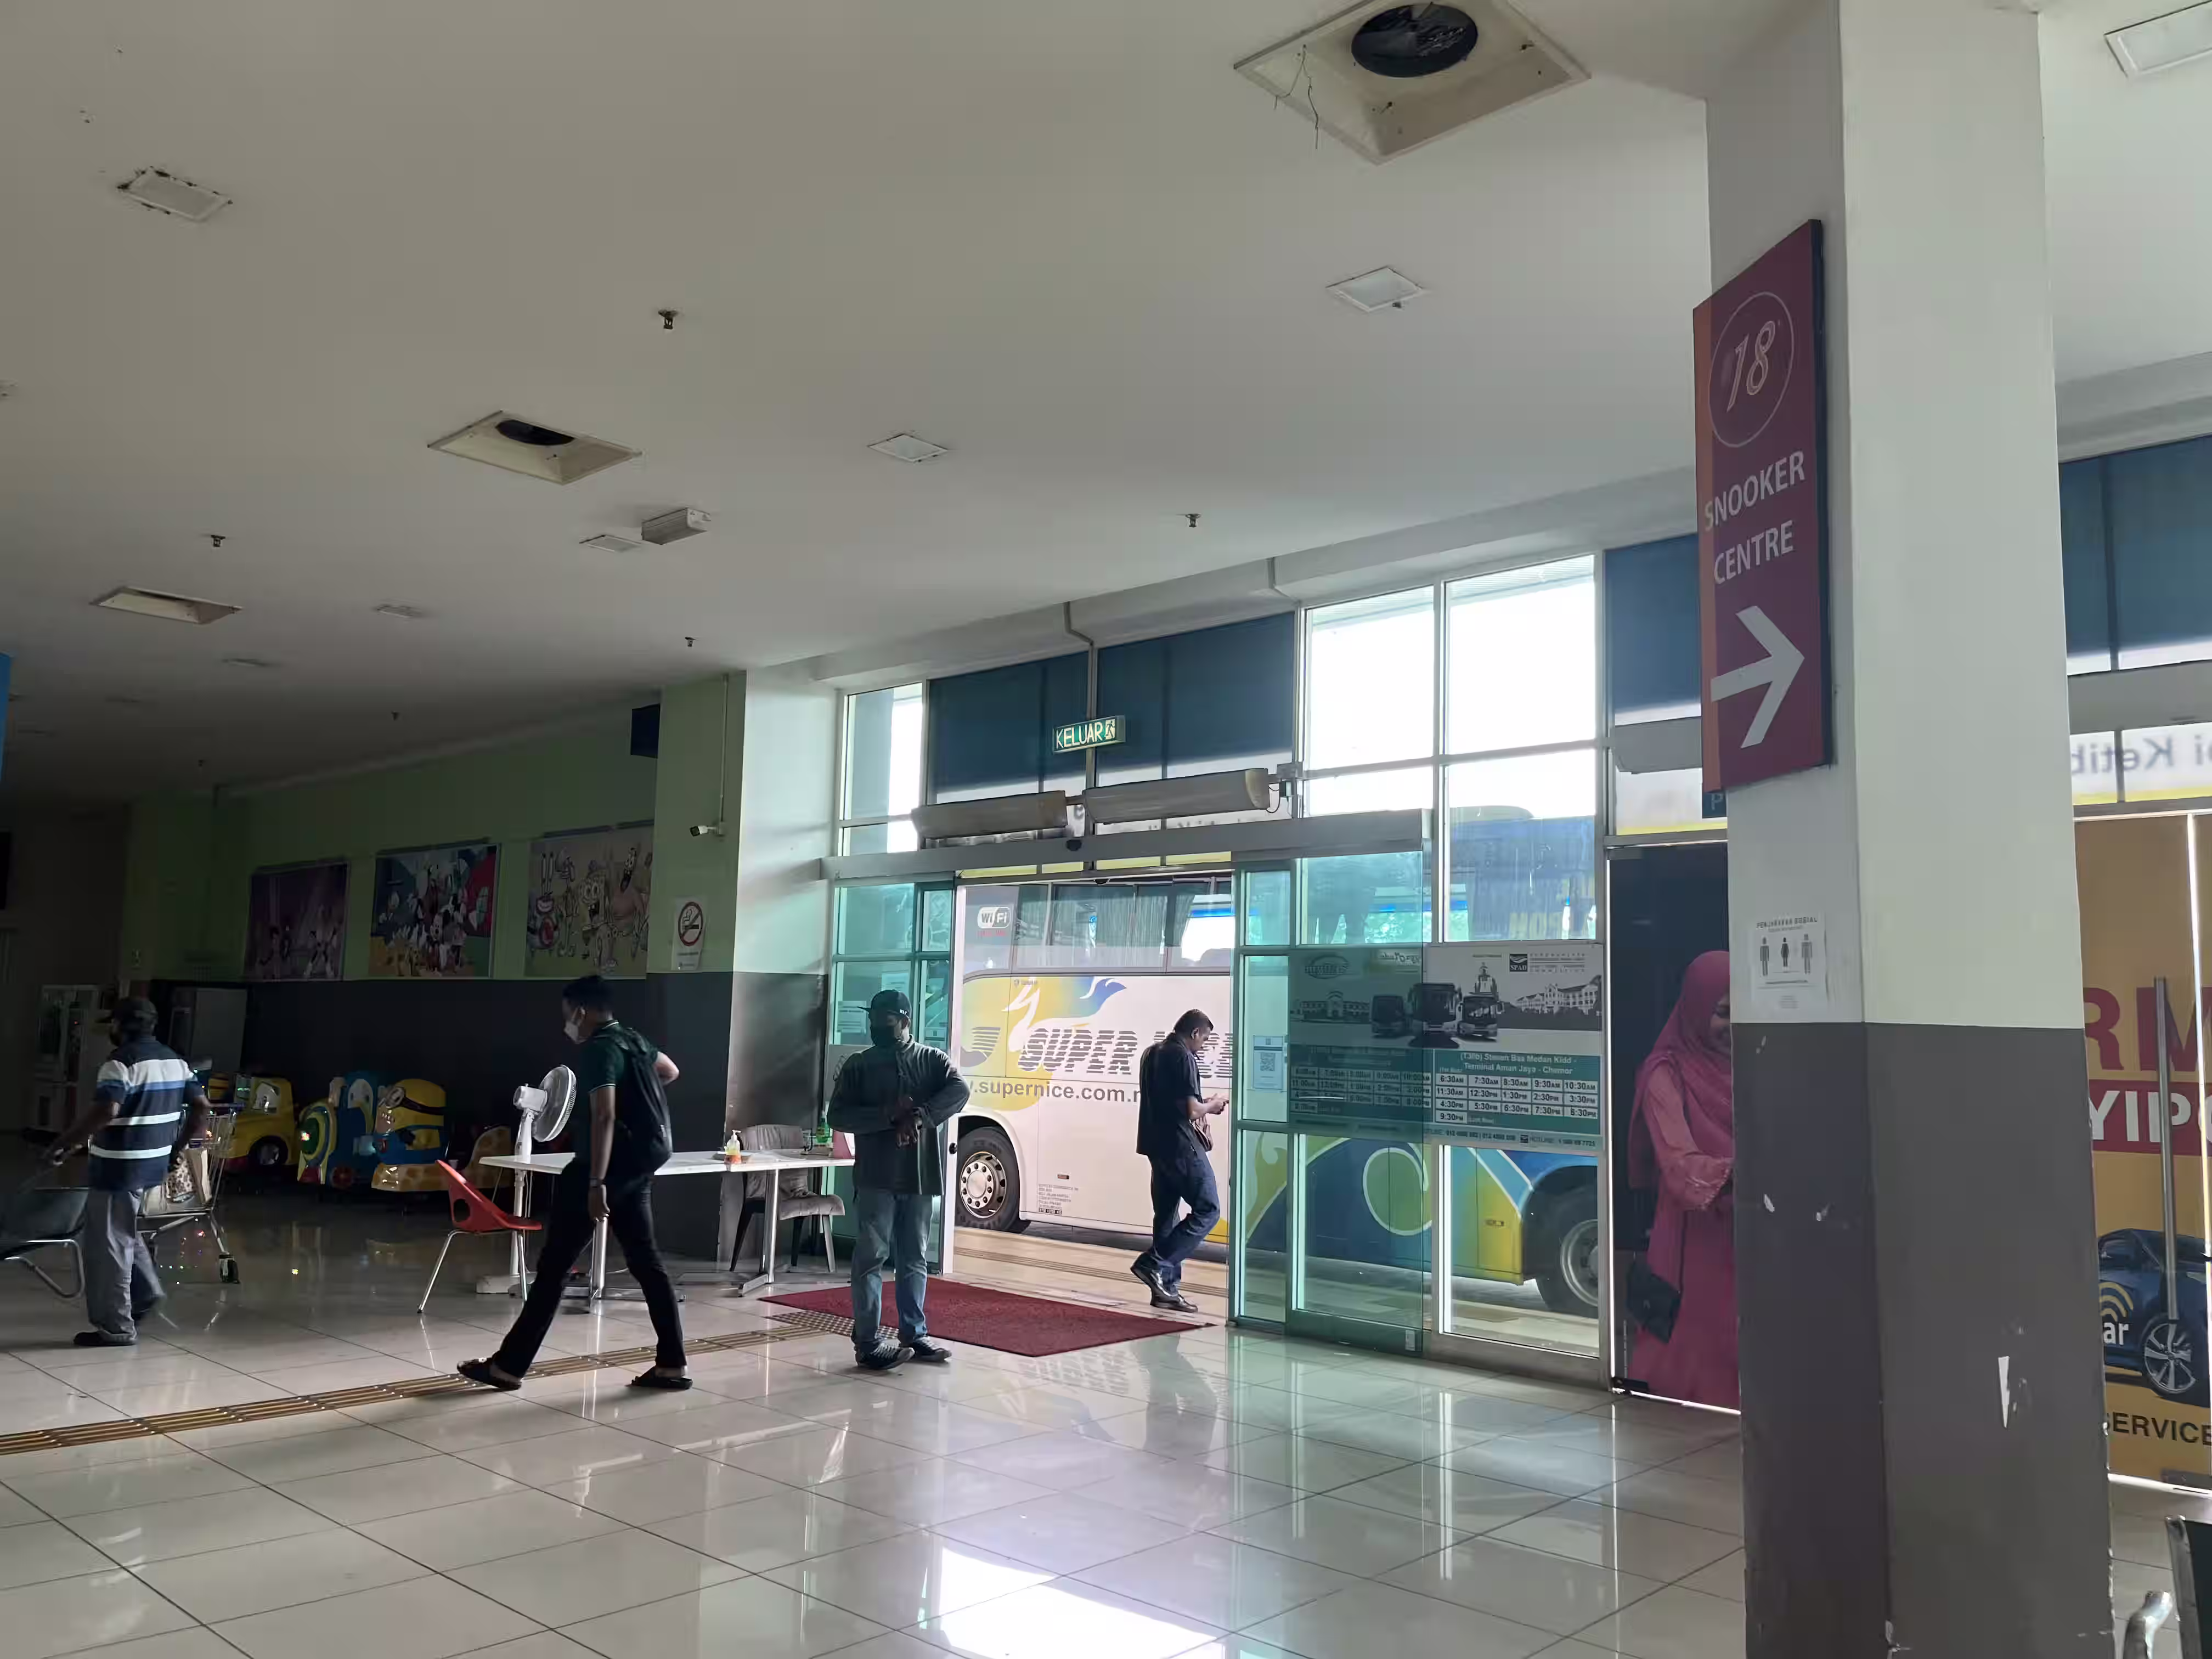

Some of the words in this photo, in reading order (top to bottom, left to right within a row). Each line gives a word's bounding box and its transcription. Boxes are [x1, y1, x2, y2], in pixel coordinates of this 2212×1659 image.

[1727, 320, 1776, 413] 18
[1705, 450, 1805, 532] SNOOKER
[1714, 520, 1794, 585] CENTRE
[1056, 721, 1103, 749] KELUAR
[1018, 1028, 1138, 1075] SUPER
[1474, 1076, 1498, 1085] 7:30AM
[1535, 1080, 1560, 1088] 9:30AM
[1565, 1082, 1596, 1090] 10:30AM
[2103, 1321, 2129, 1345] ar
[2107, 1412, 2212, 1446] ERVICE
